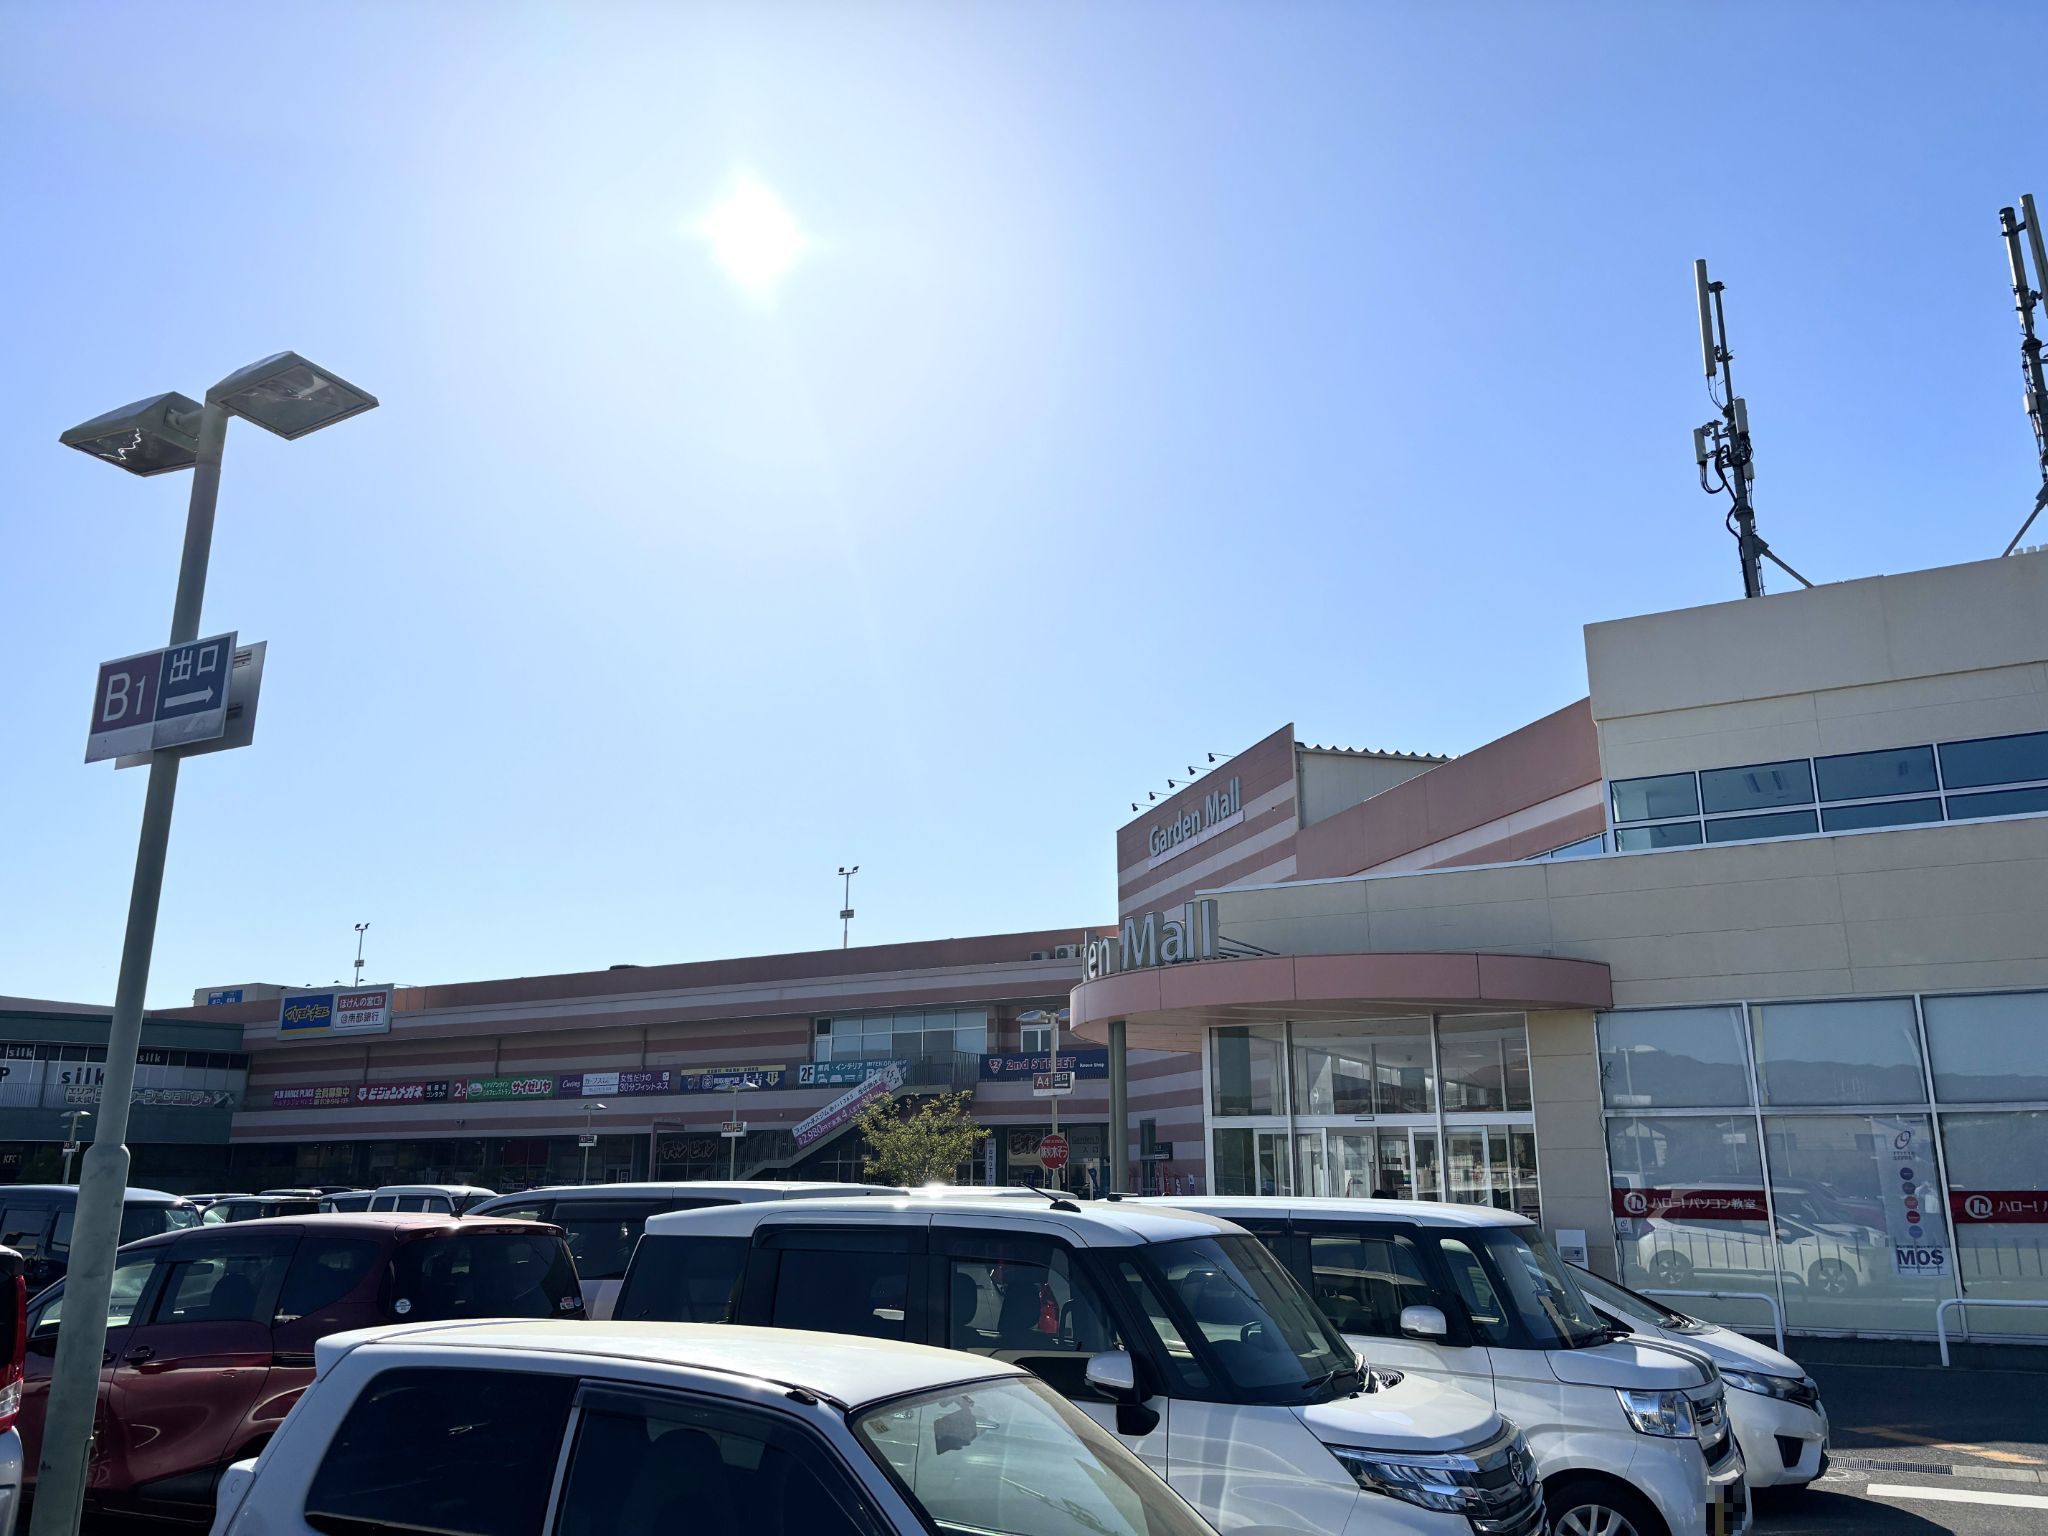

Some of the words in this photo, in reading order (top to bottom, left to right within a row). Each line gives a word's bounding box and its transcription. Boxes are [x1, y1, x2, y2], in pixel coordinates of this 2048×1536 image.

[168, 644, 219, 685] 出口
[102, 672, 147, 722] B1
[1149, 810, 1201, 857] Garden
[1205, 776, 1240, 827] Mall
[1123, 899, 1213, 970] Mall
[339, 995, 383, 1009] ほけんの窓口
[348, 1011, 379, 1024] 南都銀行
[9, 1047, 33, 1058] silk
[138, 1052, 161, 1063] silk
[1006, 1058, 1029, 1071] 2nd
[620, 1073, 652, 1083] 女性だけの
[769, 1072, 777, 1082] 1F
[801, 1066, 814, 1082] 2F
[1054, 1073, 1068, 1082] 出口
[511, 1079, 553, 1095] サイゼリヤ
[619, 1081, 669, 1092] 30分フィットネス
[1036, 1076, 1050, 1087] A4
[68, 1087, 94, 1095] エリア
[368, 1086, 423, 1101] ビジョンメガネ
[454, 1082, 467, 1097] 2F
[3, 1154, 17, 1164] KFC
[1896, 1249, 1944, 1266] MOS
